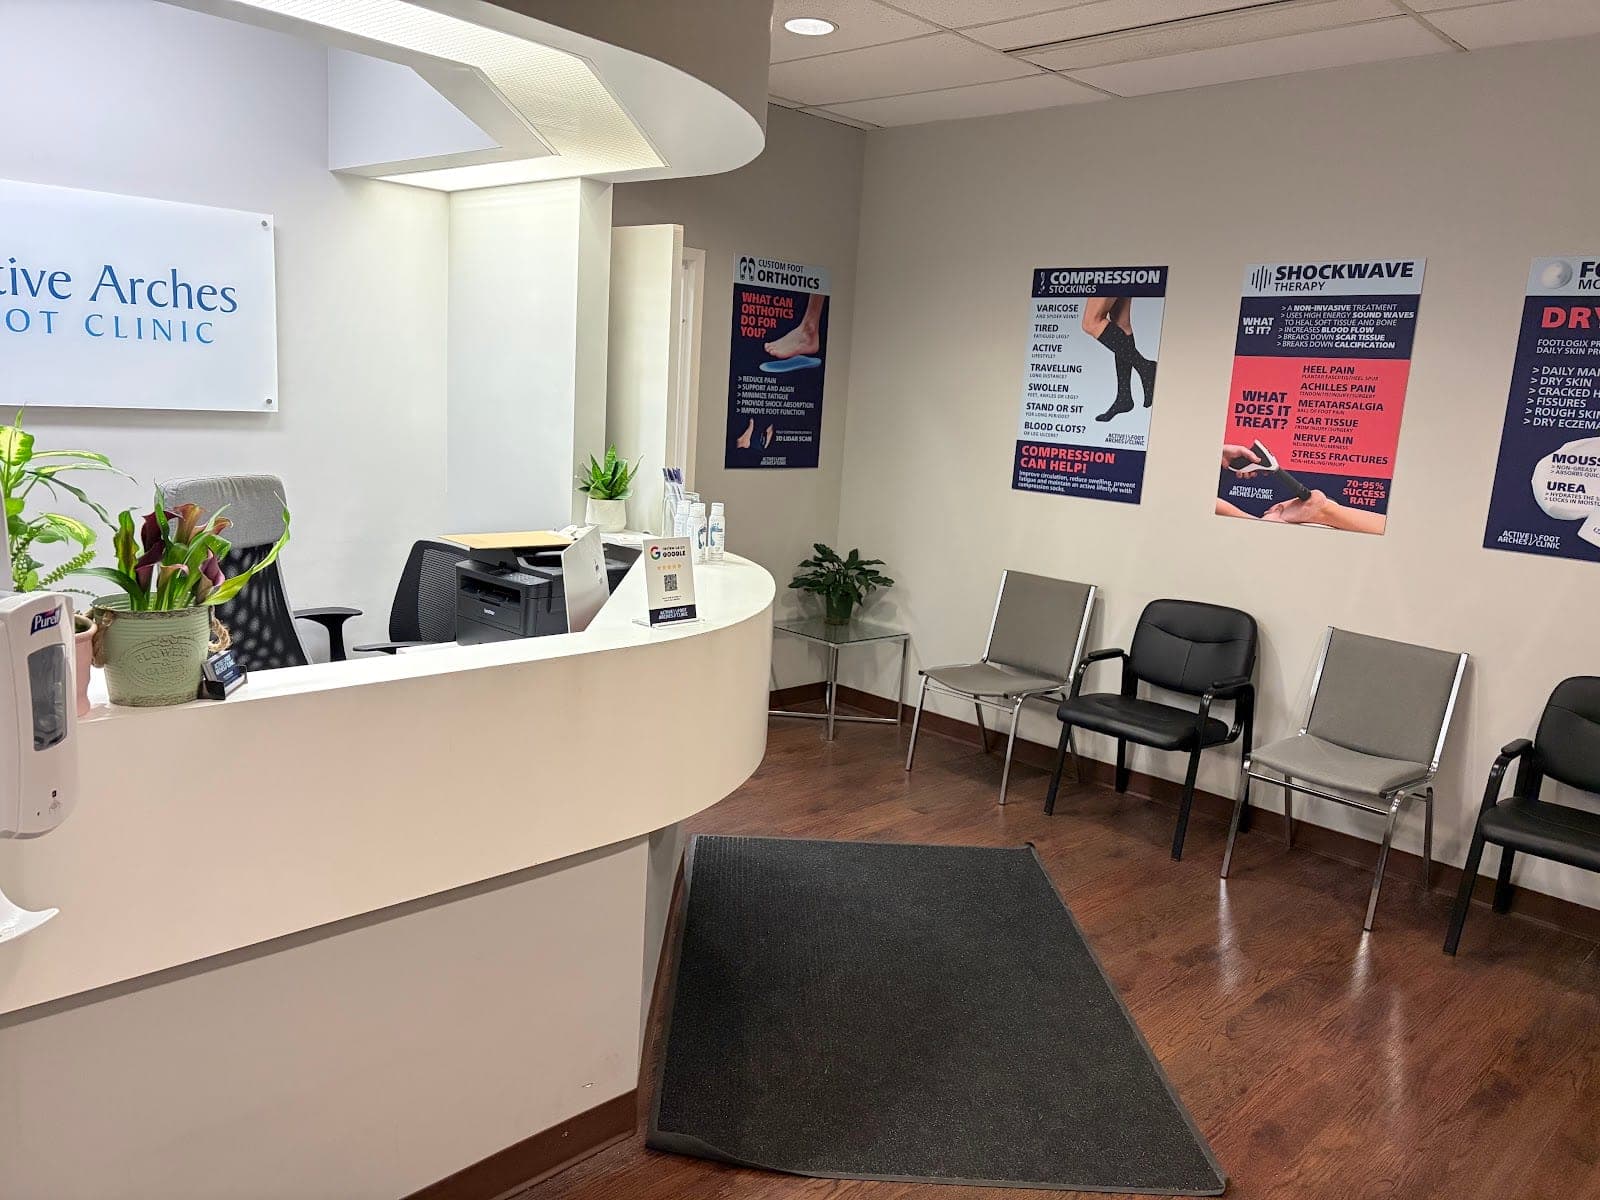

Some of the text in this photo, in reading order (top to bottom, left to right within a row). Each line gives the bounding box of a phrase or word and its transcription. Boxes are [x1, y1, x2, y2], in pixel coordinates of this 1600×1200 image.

[759, 260, 804, 273] CUSTOM FOOT
[1275, 262, 1414, 281] SHOCKWAVE
[758, 270, 820, 289] ORTHOTICS
[1050, 270, 1161, 285] COMPRESSION
[89, 265, 238, 313] Arches
[1049, 285, 1097, 294] STOCKINGS
[1274, 281, 1326, 292] THERAPY
[742, 292, 793, 307] WHAT CAN
[742, 304, 794, 319] ORTHOTICS
[1037, 304, 1079, 312] VARICOSE
[1383, 311, 1414, 319] WAVES
[741, 316, 776, 328] DO FOR
[1242, 317, 1274, 326] WHAT
[85, 314, 214, 344] CLINIC
[741, 327, 766, 338] YOU?
[1034, 324, 1059, 332] TIRED
[1245, 326, 1272, 335] IS IT?
[1032, 344, 1063, 352] ACTIVE
[1537, 338, 1588, 348] FOOTLOGIX
[1565, 347, 1585, 355] SKIN
[1031, 363, 1082, 373] TRAVELLING
[1303, 365, 1355, 374] HEEL PAIN
[1542, 366, 1575, 376] DAILY
[1028, 383, 1069, 392] SWOLLEN
[1540, 377, 1592, 387] DRY SKIN
[1300, 383, 1376, 393] ACHILLES PAIN
[1538, 387, 1590, 398] CRACKED
[1242, 390, 1287, 403] WHAT
[1026, 402, 1054, 411] STAND
[1070, 405, 1084, 413] SIT
[1298, 400, 1384, 411] METATARSALGIA
[1536, 397, 1586, 408] FISSURES
[1234, 402, 1292, 417] DOES IT
[1534, 407, 1575, 418] ROUGH
[1024, 421, 1086, 433] BLOOD CLOTS?
[1235, 416, 1288, 430] TREAT?
[1296, 417, 1358, 427] SCAR TISSUE
[1533, 417, 1556, 427] DRY
[1294, 433, 1353, 445] NERVE PAIN
[1021, 445, 1115, 464] COMPRESSION
[1291, 450, 1388, 465] STRESS FRACTURES
[1020, 457, 1087, 474] CAN HELP!
[1346, 480, 1384, 490] 70-95%
[1547, 481, 1586, 493] UREA
[1342, 488, 1386, 499] SUCCESS
[1349, 497, 1377, 507] RATE
[1503, 530, 1529, 540] ACTIVE
[1498, 536, 1560, 549] ARCHES CLINIC
